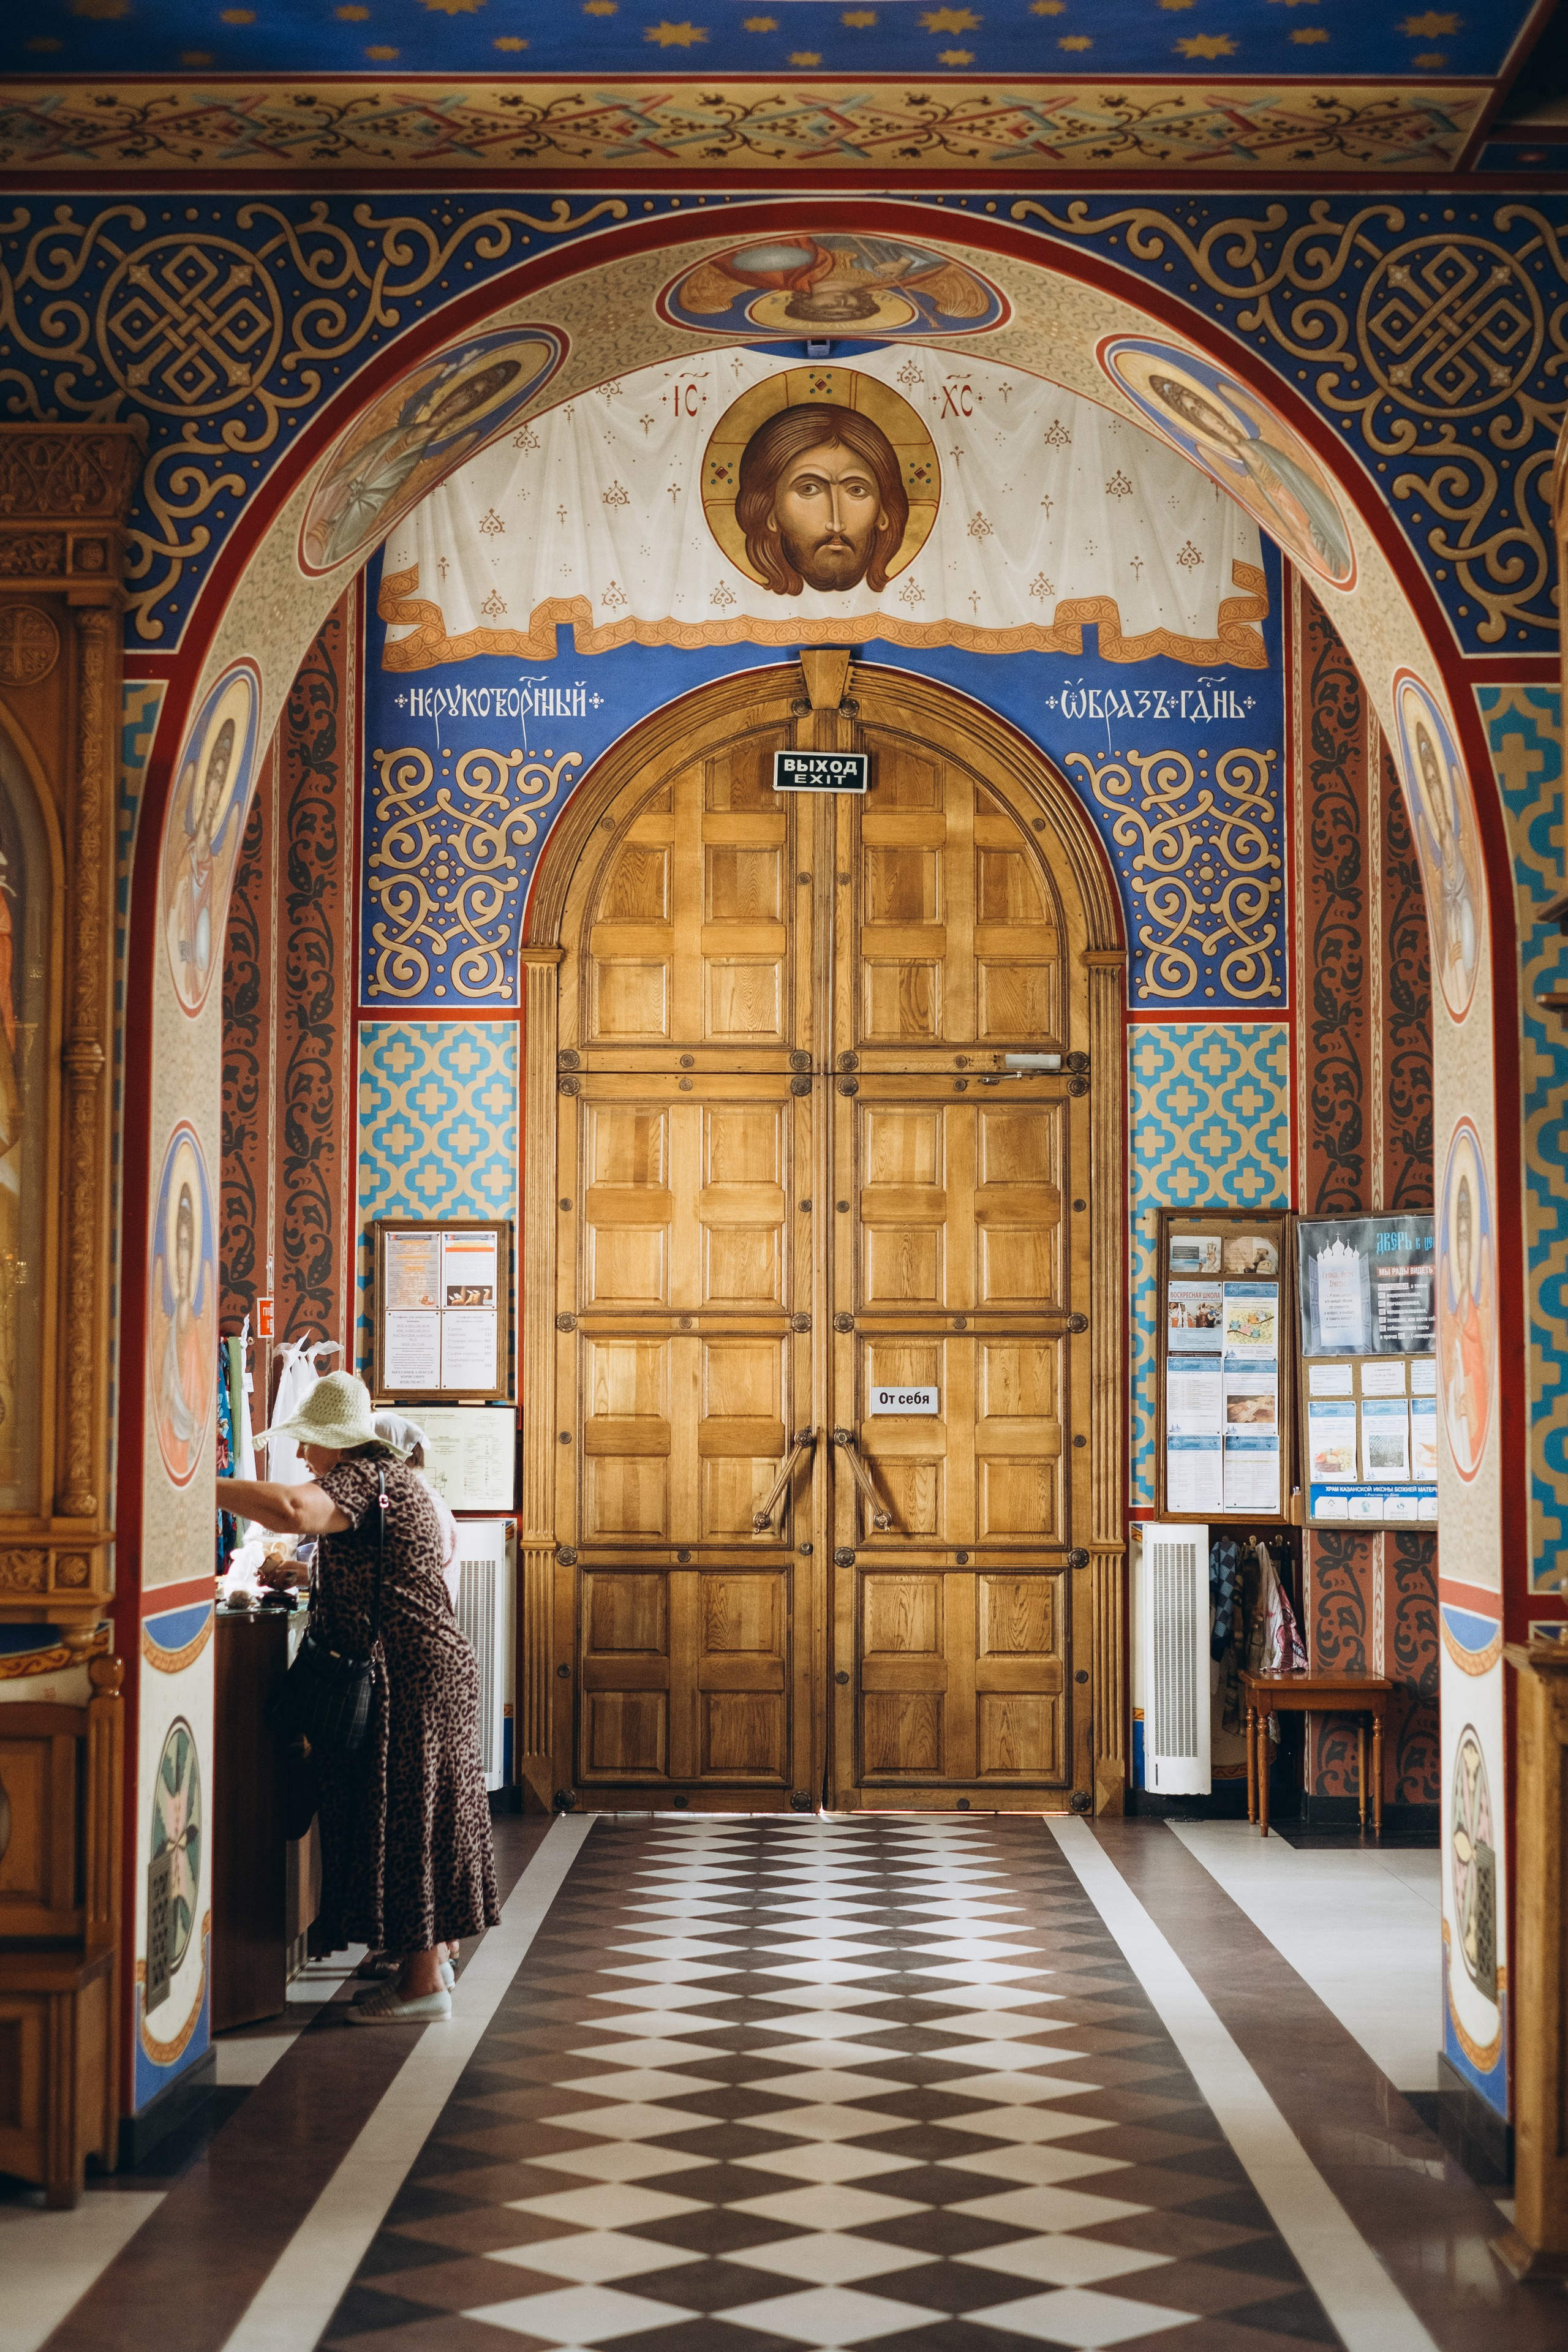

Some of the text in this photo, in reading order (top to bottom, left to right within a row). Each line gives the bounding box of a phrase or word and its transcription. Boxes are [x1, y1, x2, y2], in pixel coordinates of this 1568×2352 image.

[784, 759, 858, 775] ВЫХОД
[794, 774, 846, 785] EXIT
[1410, 1266, 1433, 1275] ВИДЕТЬ
[880, 1392, 929, 1404] От себя
